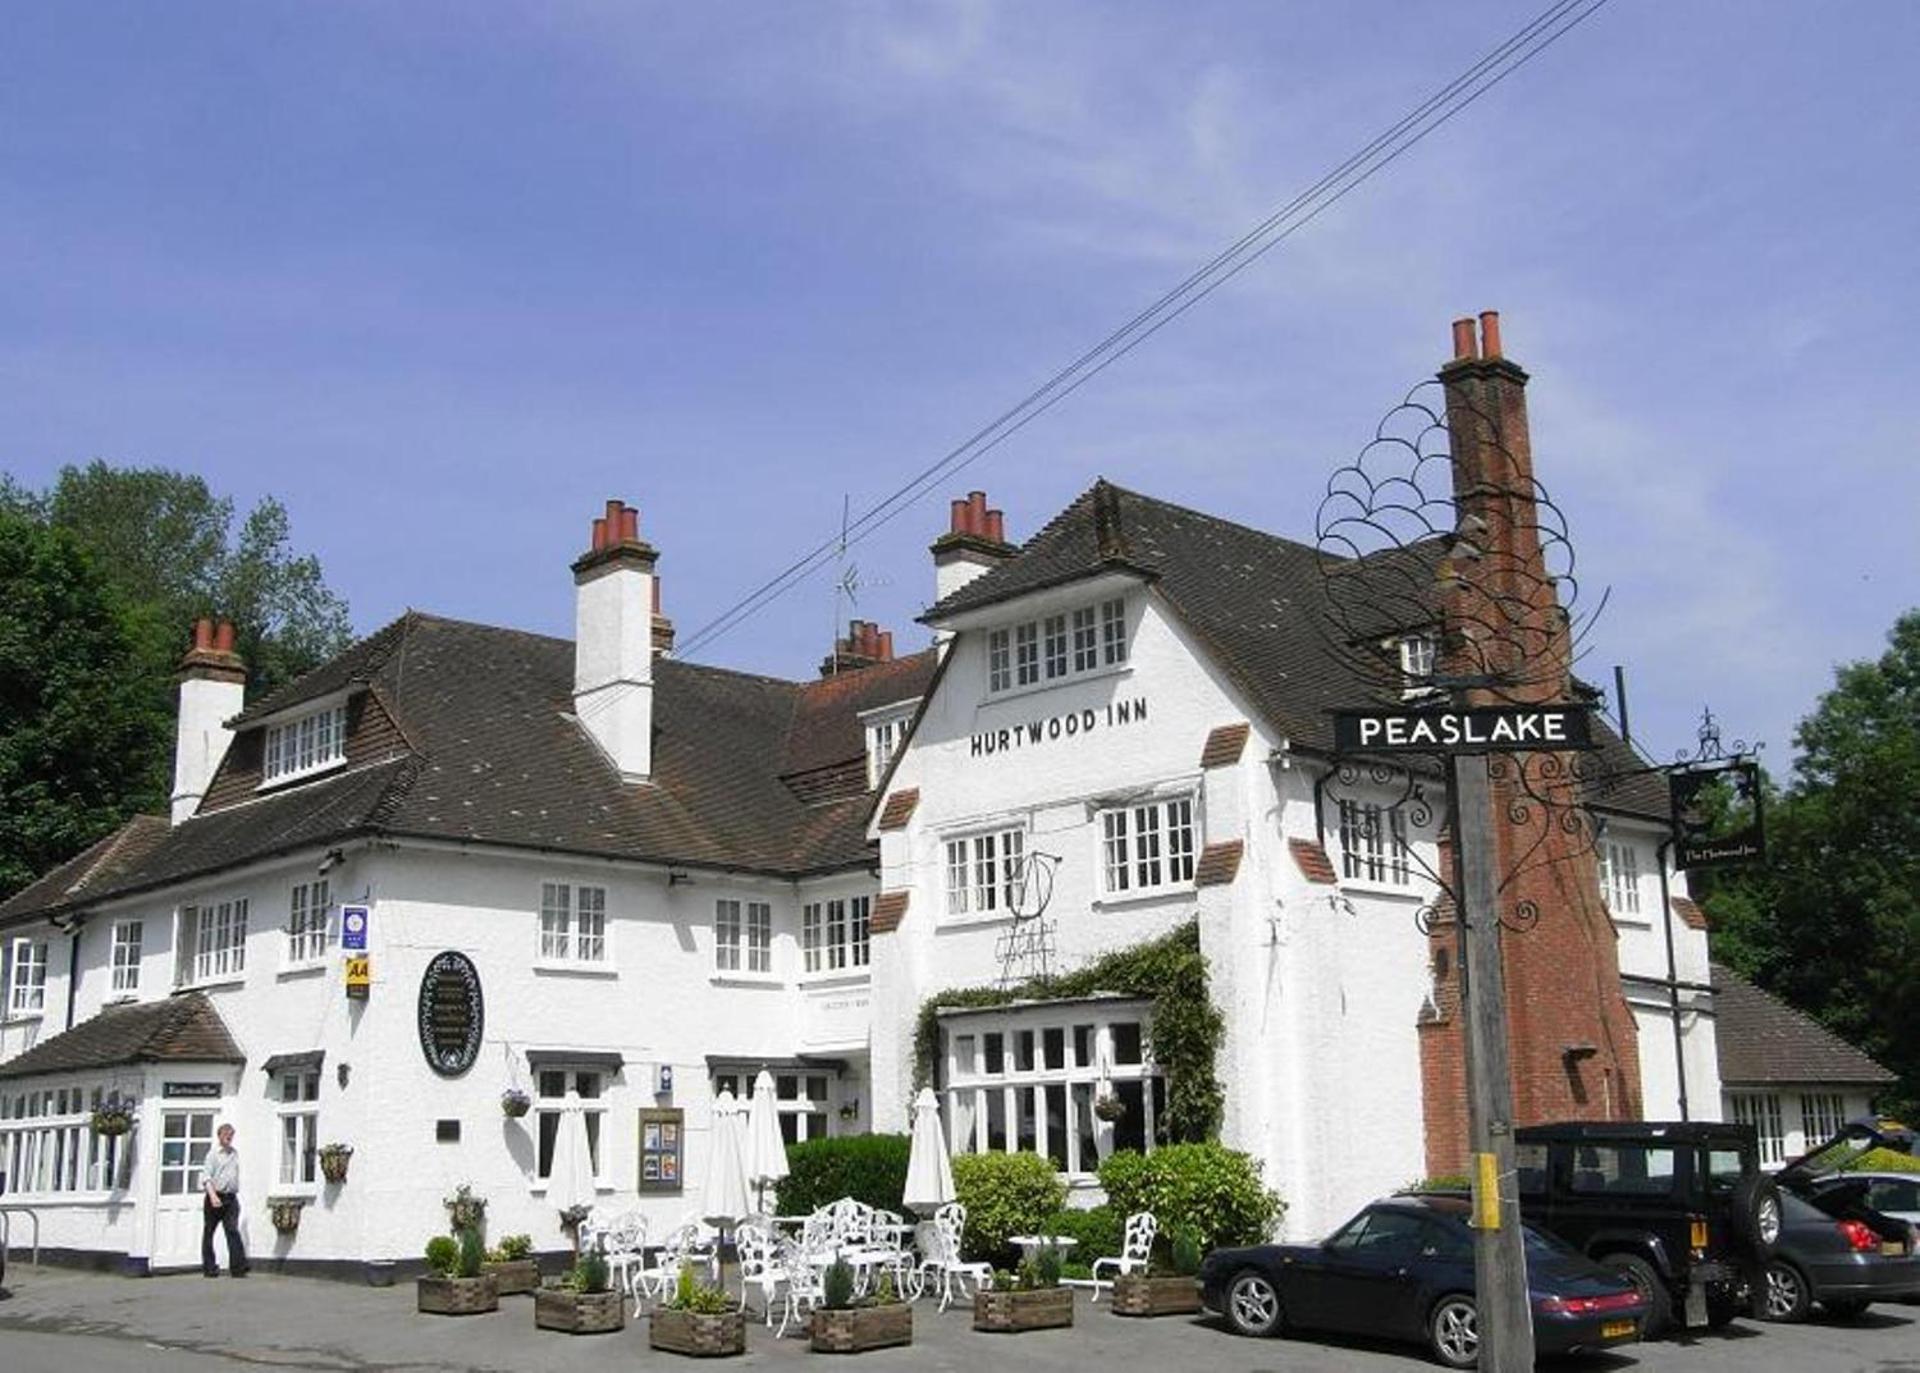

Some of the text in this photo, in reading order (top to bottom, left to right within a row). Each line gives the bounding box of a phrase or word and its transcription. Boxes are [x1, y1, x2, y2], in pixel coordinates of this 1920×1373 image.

[971, 697, 1148, 758] HURTWOOD INN
[1359, 713, 1568, 746] PEASLAKE
[348, 963, 368, 978] AA
